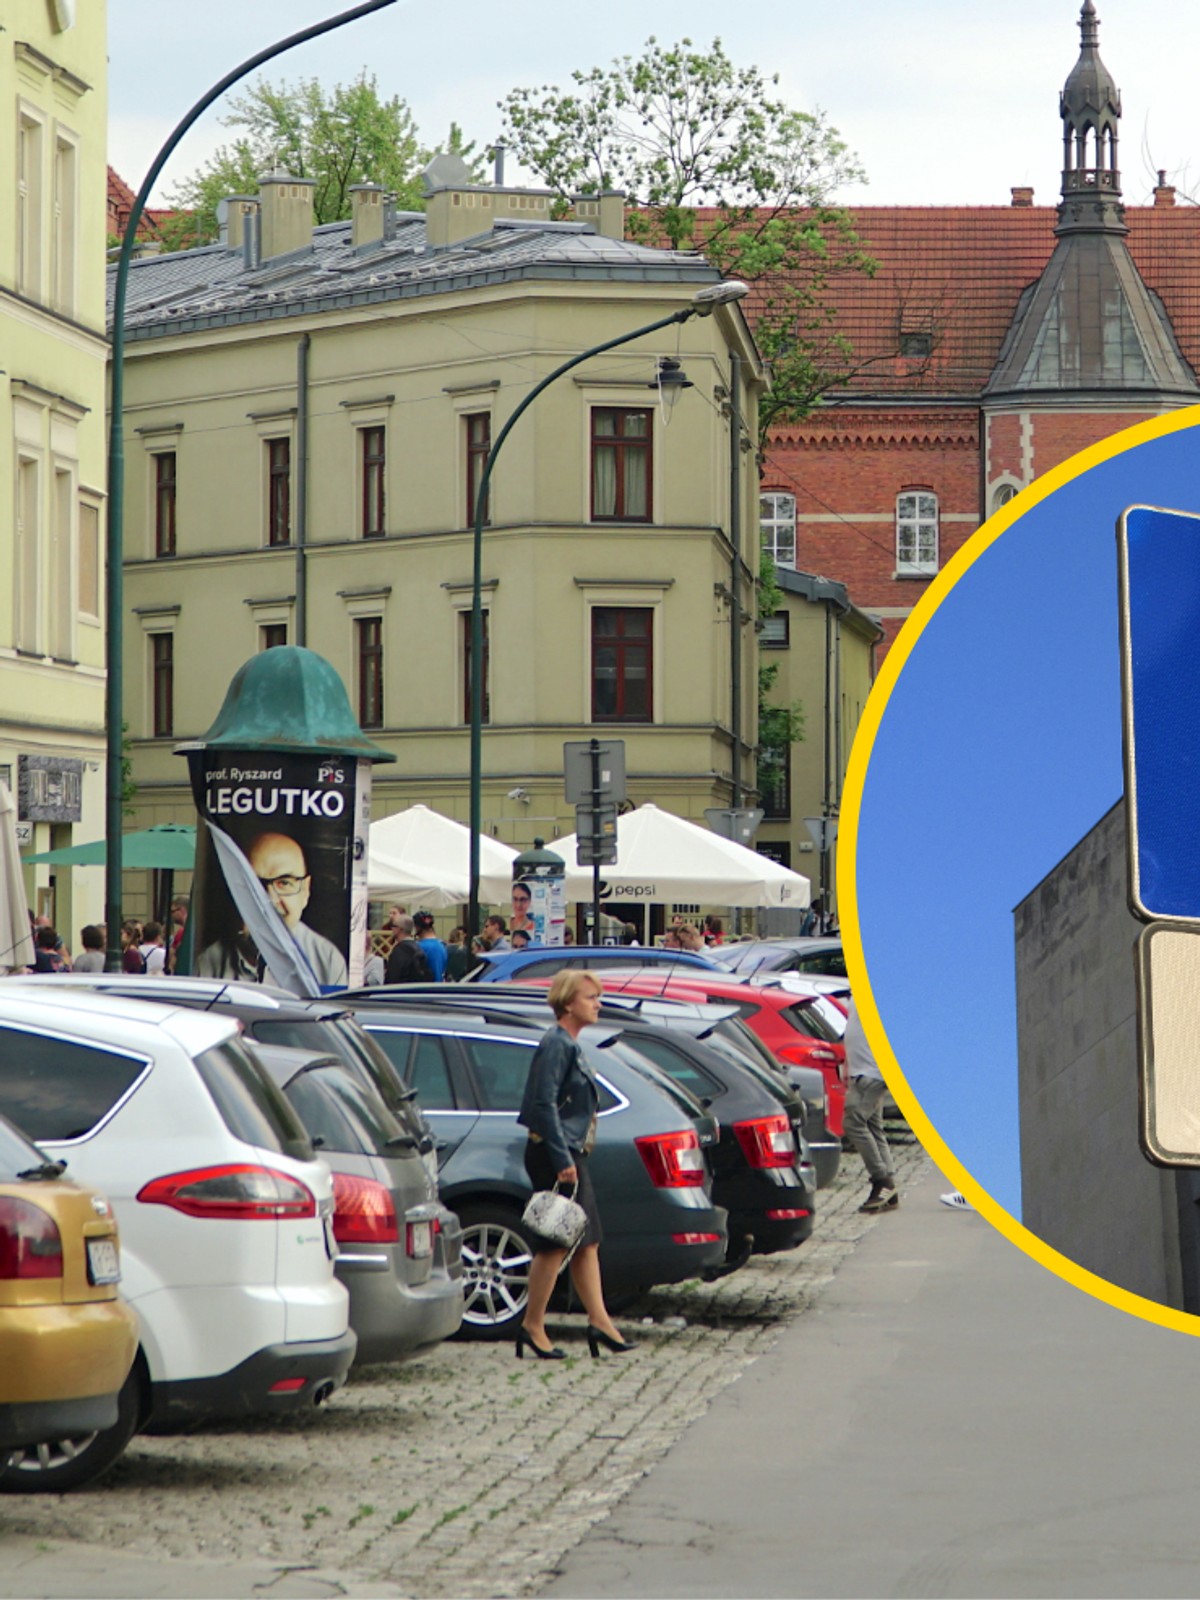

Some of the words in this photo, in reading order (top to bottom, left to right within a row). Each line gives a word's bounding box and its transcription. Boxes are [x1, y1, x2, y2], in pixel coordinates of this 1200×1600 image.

[206, 768, 228, 783] prof.
[230, 768, 282, 783] Ryszard
[318, 767, 344, 784] PiS
[206, 787, 344, 817] LEGUTKO
[615, 884, 656, 898] pepsi
